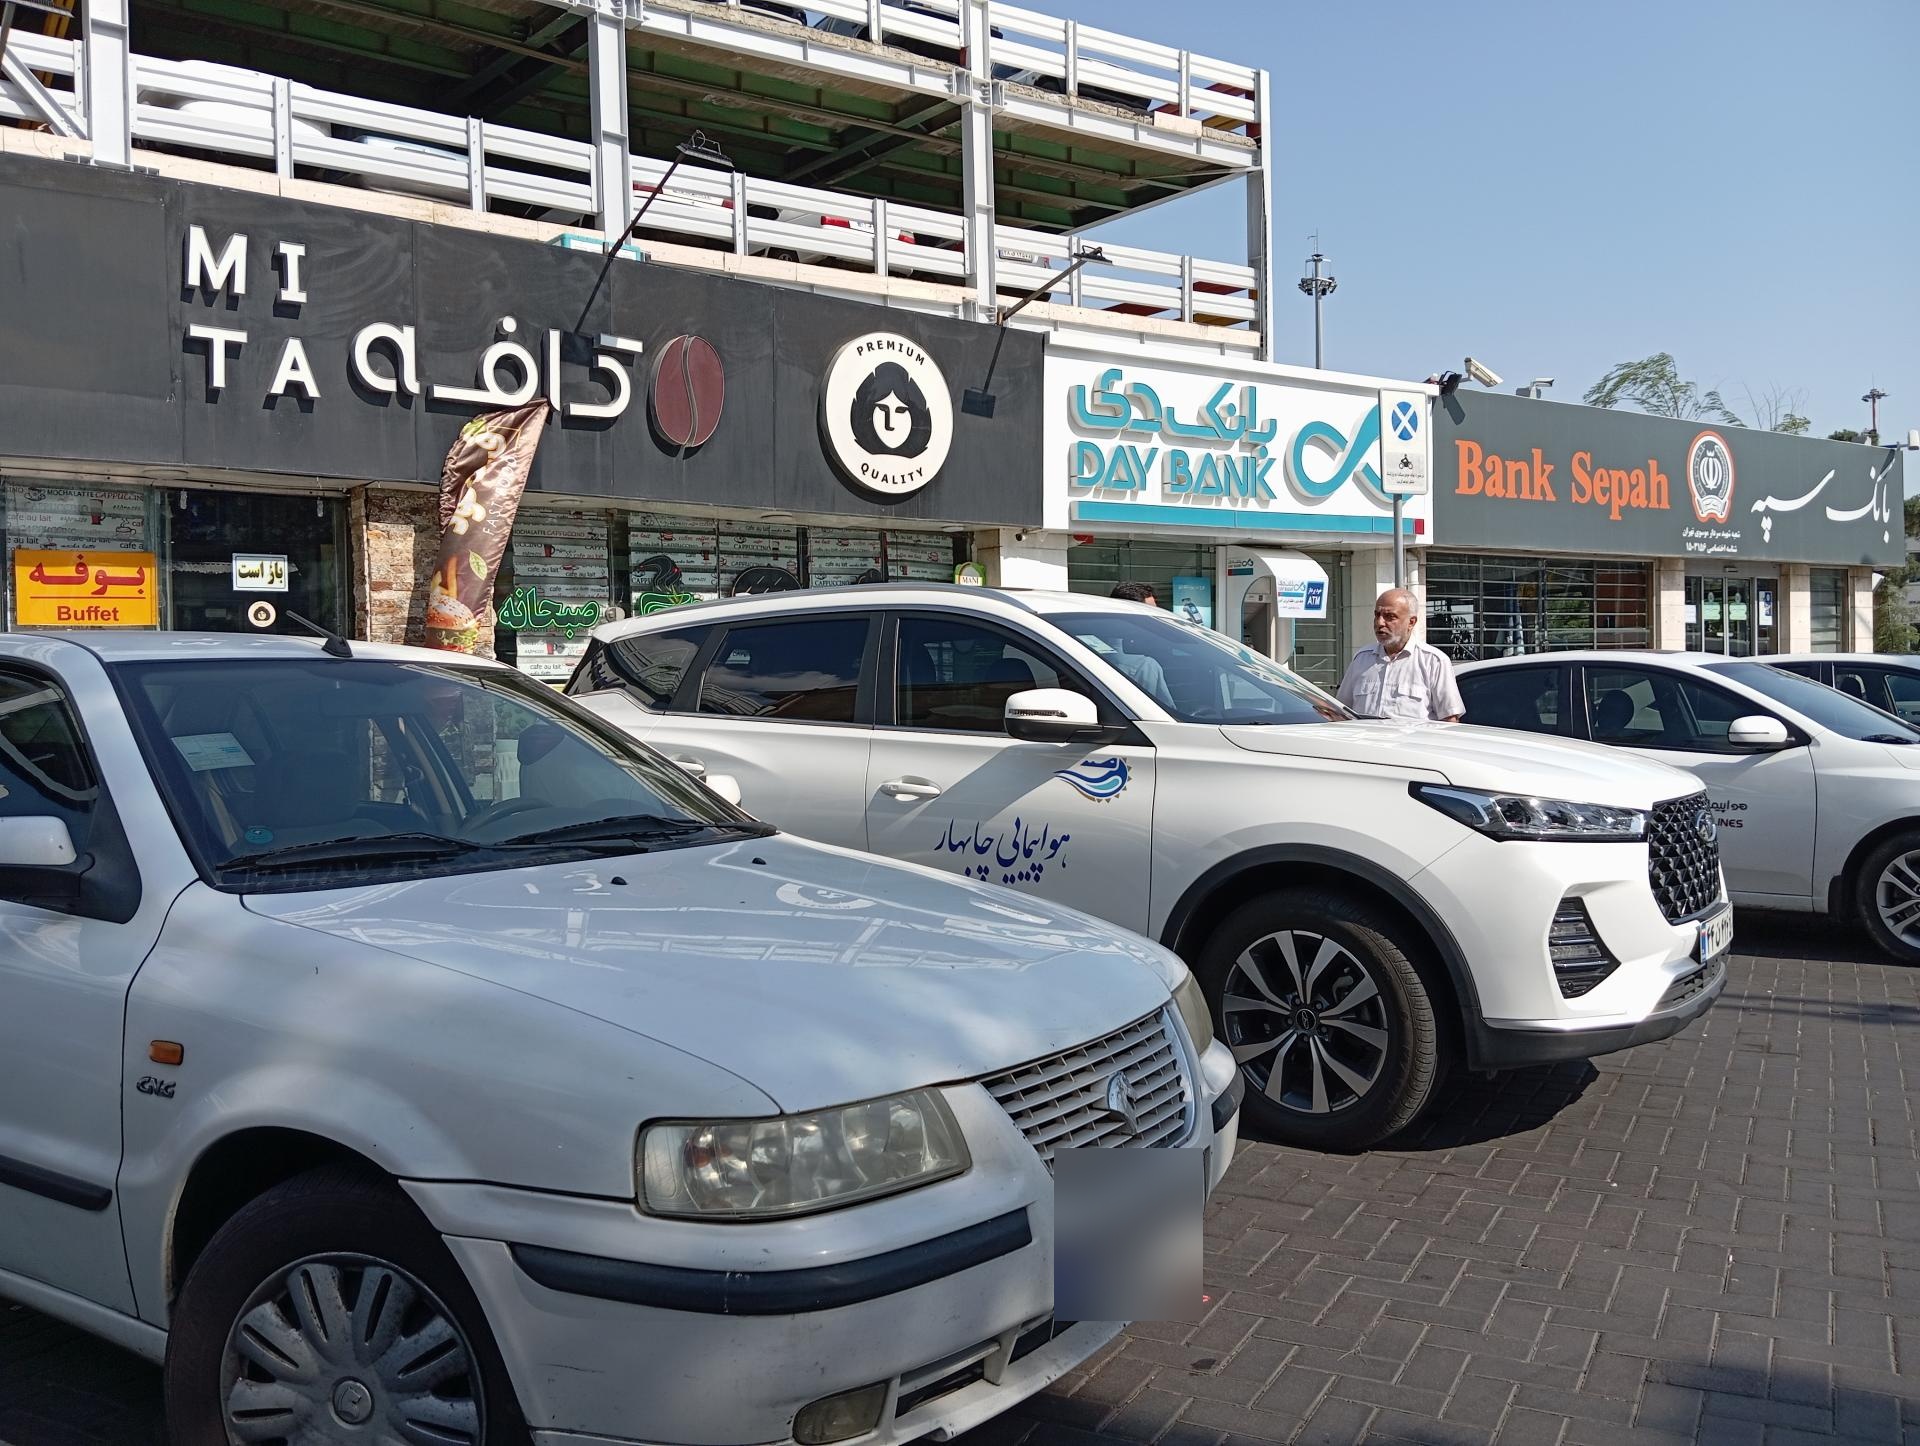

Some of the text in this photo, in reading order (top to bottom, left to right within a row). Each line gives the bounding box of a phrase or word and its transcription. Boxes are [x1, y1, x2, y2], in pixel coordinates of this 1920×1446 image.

[186, 224, 307, 303] MI
[188, 324, 321, 398] TA
[352, 315, 644, 418] کافه
[857, 340, 925, 365] PREMIUM
[1074, 368, 1278, 459] بانک دی
[860, 463, 924, 484] QUALITY
[1073, 441, 1278, 500] DAY BANK
[1455, 439, 1671, 521] Bank Sepah
[482, 501, 501, 536] FAST
[1750, 457, 1896, 544] بانک سپه
[28, 553, 146, 596] بوفه
[238, 561, 284, 585] باز است
[57, 605, 120, 622] Buffet
[498, 586, 601, 640] صبحانه
[1306, 596, 1321, 606] ATM
[933, 816, 1071, 884] هواپیمایی چابهار
[1715, 818, 1744, 828] INES
